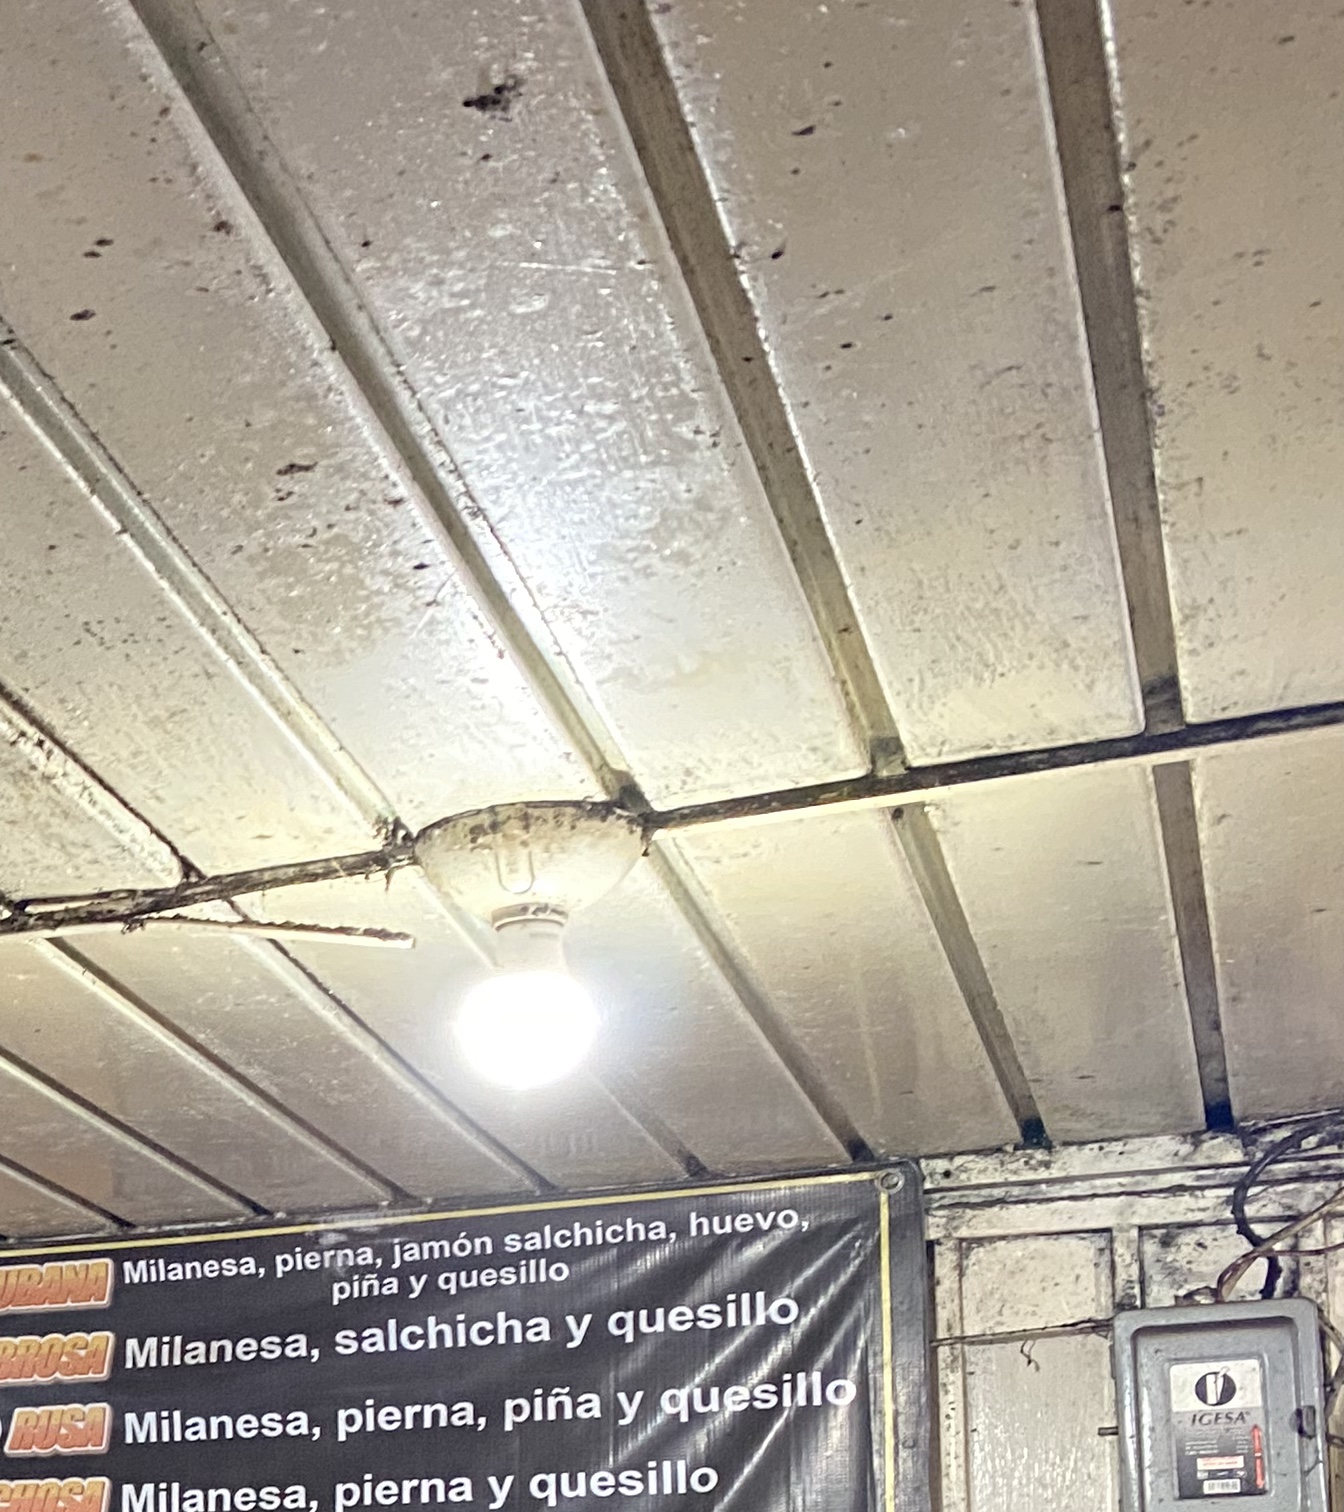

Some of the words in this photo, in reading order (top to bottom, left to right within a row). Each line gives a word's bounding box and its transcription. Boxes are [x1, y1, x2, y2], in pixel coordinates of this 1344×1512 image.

[123, 1253, 265, 1285] Milanesa,
[275, 1245, 383, 1277] pierna,
[391, 1230, 492, 1270] jamón
[505, 1216, 677, 1255] salchicha,
[689, 1206, 810, 1237] huevo,
[332, 1266, 399, 1305] piña
[408, 1273, 427, 1299] y
[438, 1259, 570, 1297] quesillo
[125, 1331, 320, 1370] Milanesa,
[334, 1309, 551, 1356] salchicha
[565, 1313, 593, 1349] y
[607, 1291, 799, 1336] quesillo
[8, 1404, 110, 1454] RUSA
[124, 1405, 321, 1445] Milanesa,
[336, 1398, 487, 1441] pierna,
[504, 1387, 601, 1430] piña
[616, 1389, 644, 1424] y
[661, 1371, 858, 1421] quesillo
[487, 1474, 514, 1509] y
[529, 1459, 719, 1510] quesillo
